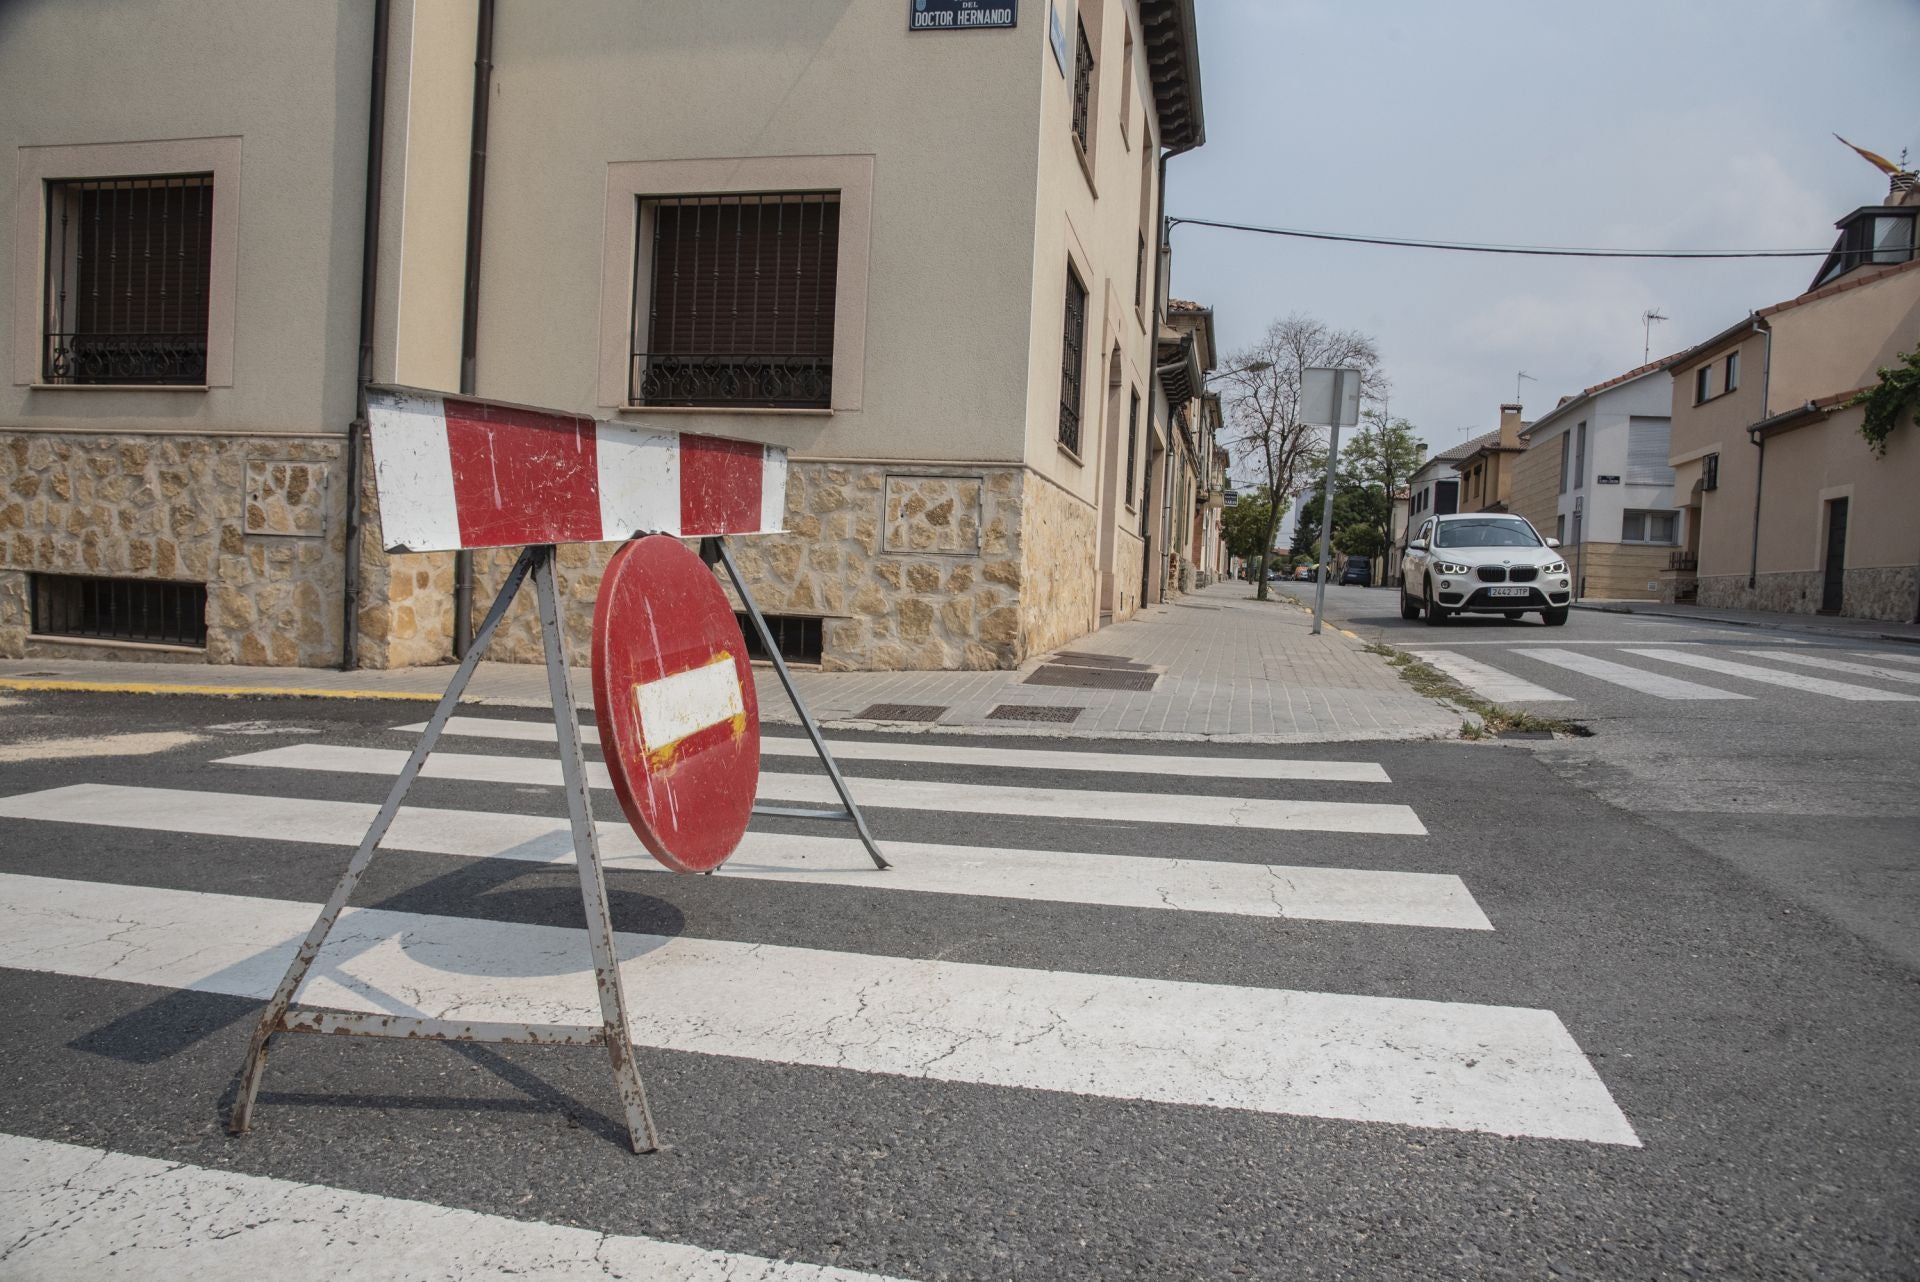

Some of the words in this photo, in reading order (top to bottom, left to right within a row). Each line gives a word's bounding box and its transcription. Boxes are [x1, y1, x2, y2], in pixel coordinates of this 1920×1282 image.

[915, 11, 953, 26] DOCTOR
[957, 9, 1011, 25] HERNANDO
[1492, 588, 1511, 596] 2442
[1513, 588, 1528, 596] JTP
